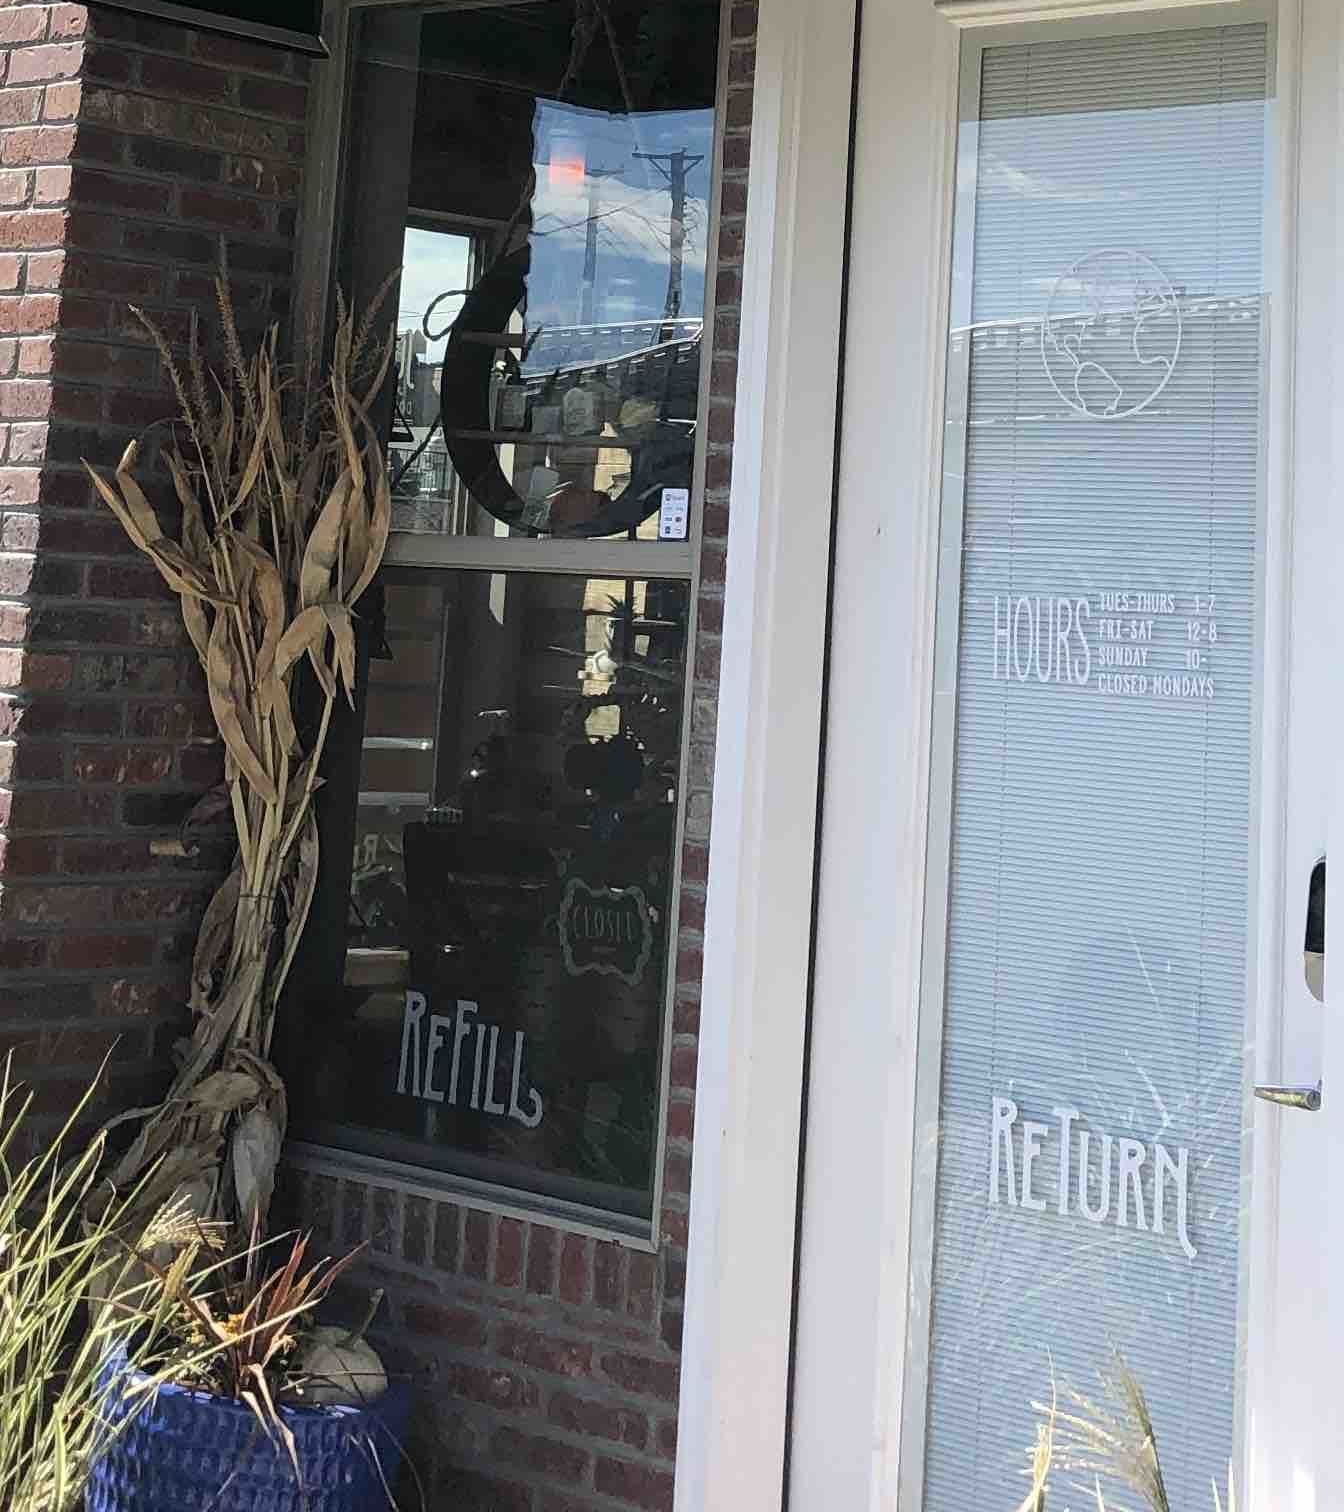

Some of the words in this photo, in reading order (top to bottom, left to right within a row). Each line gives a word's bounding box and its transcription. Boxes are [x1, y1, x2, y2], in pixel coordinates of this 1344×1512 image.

[993, 594, 1091, 686] HOURS
[1097, 647, 1149, 667] SUNDAY
[1097, 673, 1147, 695] CLOSED
[1152, 675, 1215, 699] MONDAYS
